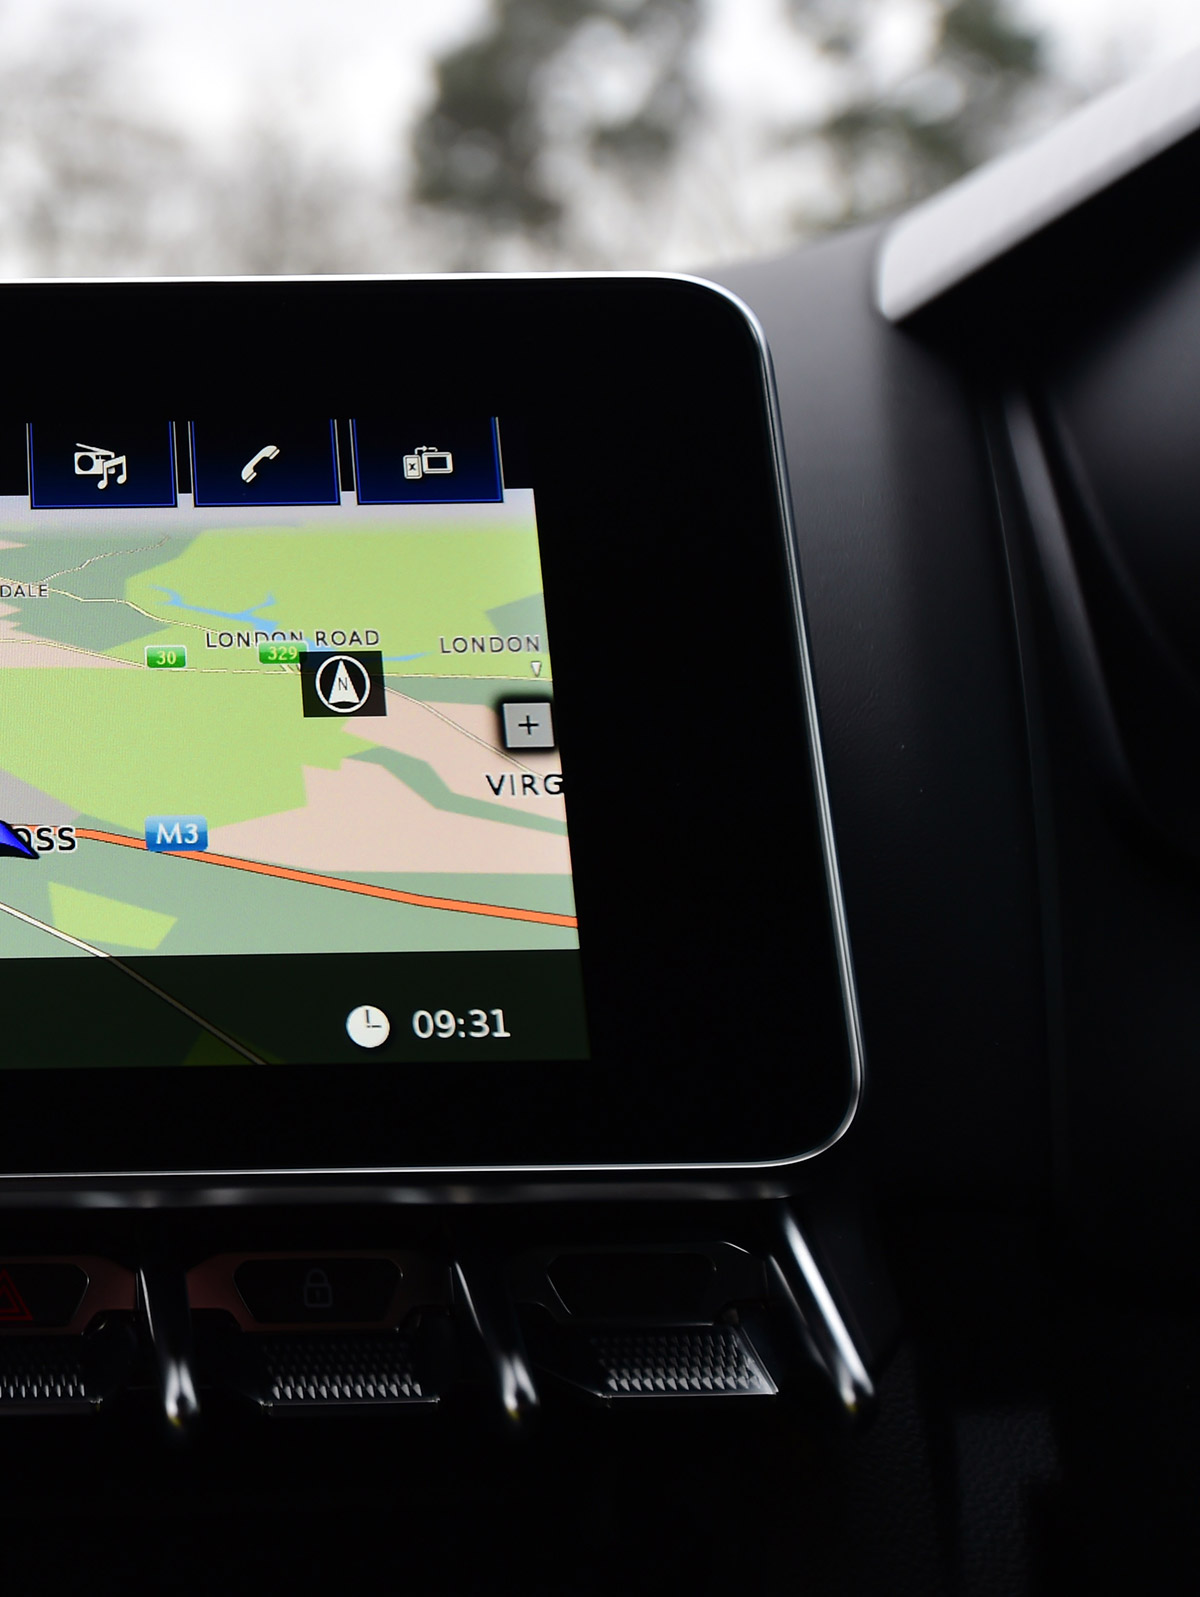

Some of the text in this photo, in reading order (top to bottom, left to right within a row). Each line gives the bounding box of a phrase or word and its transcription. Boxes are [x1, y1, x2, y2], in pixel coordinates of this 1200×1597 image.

[315, 630, 380, 646] ROAD
[439, 636, 540, 654] LONDON
[156, 651, 176, 664] 30
[267, 645, 298, 661] 329
[338, 677, 349, 692] N
[485, 774, 564, 796] VIRG
[156, 824, 198, 845] M3
[412, 1009, 511, 1038] 09:31
